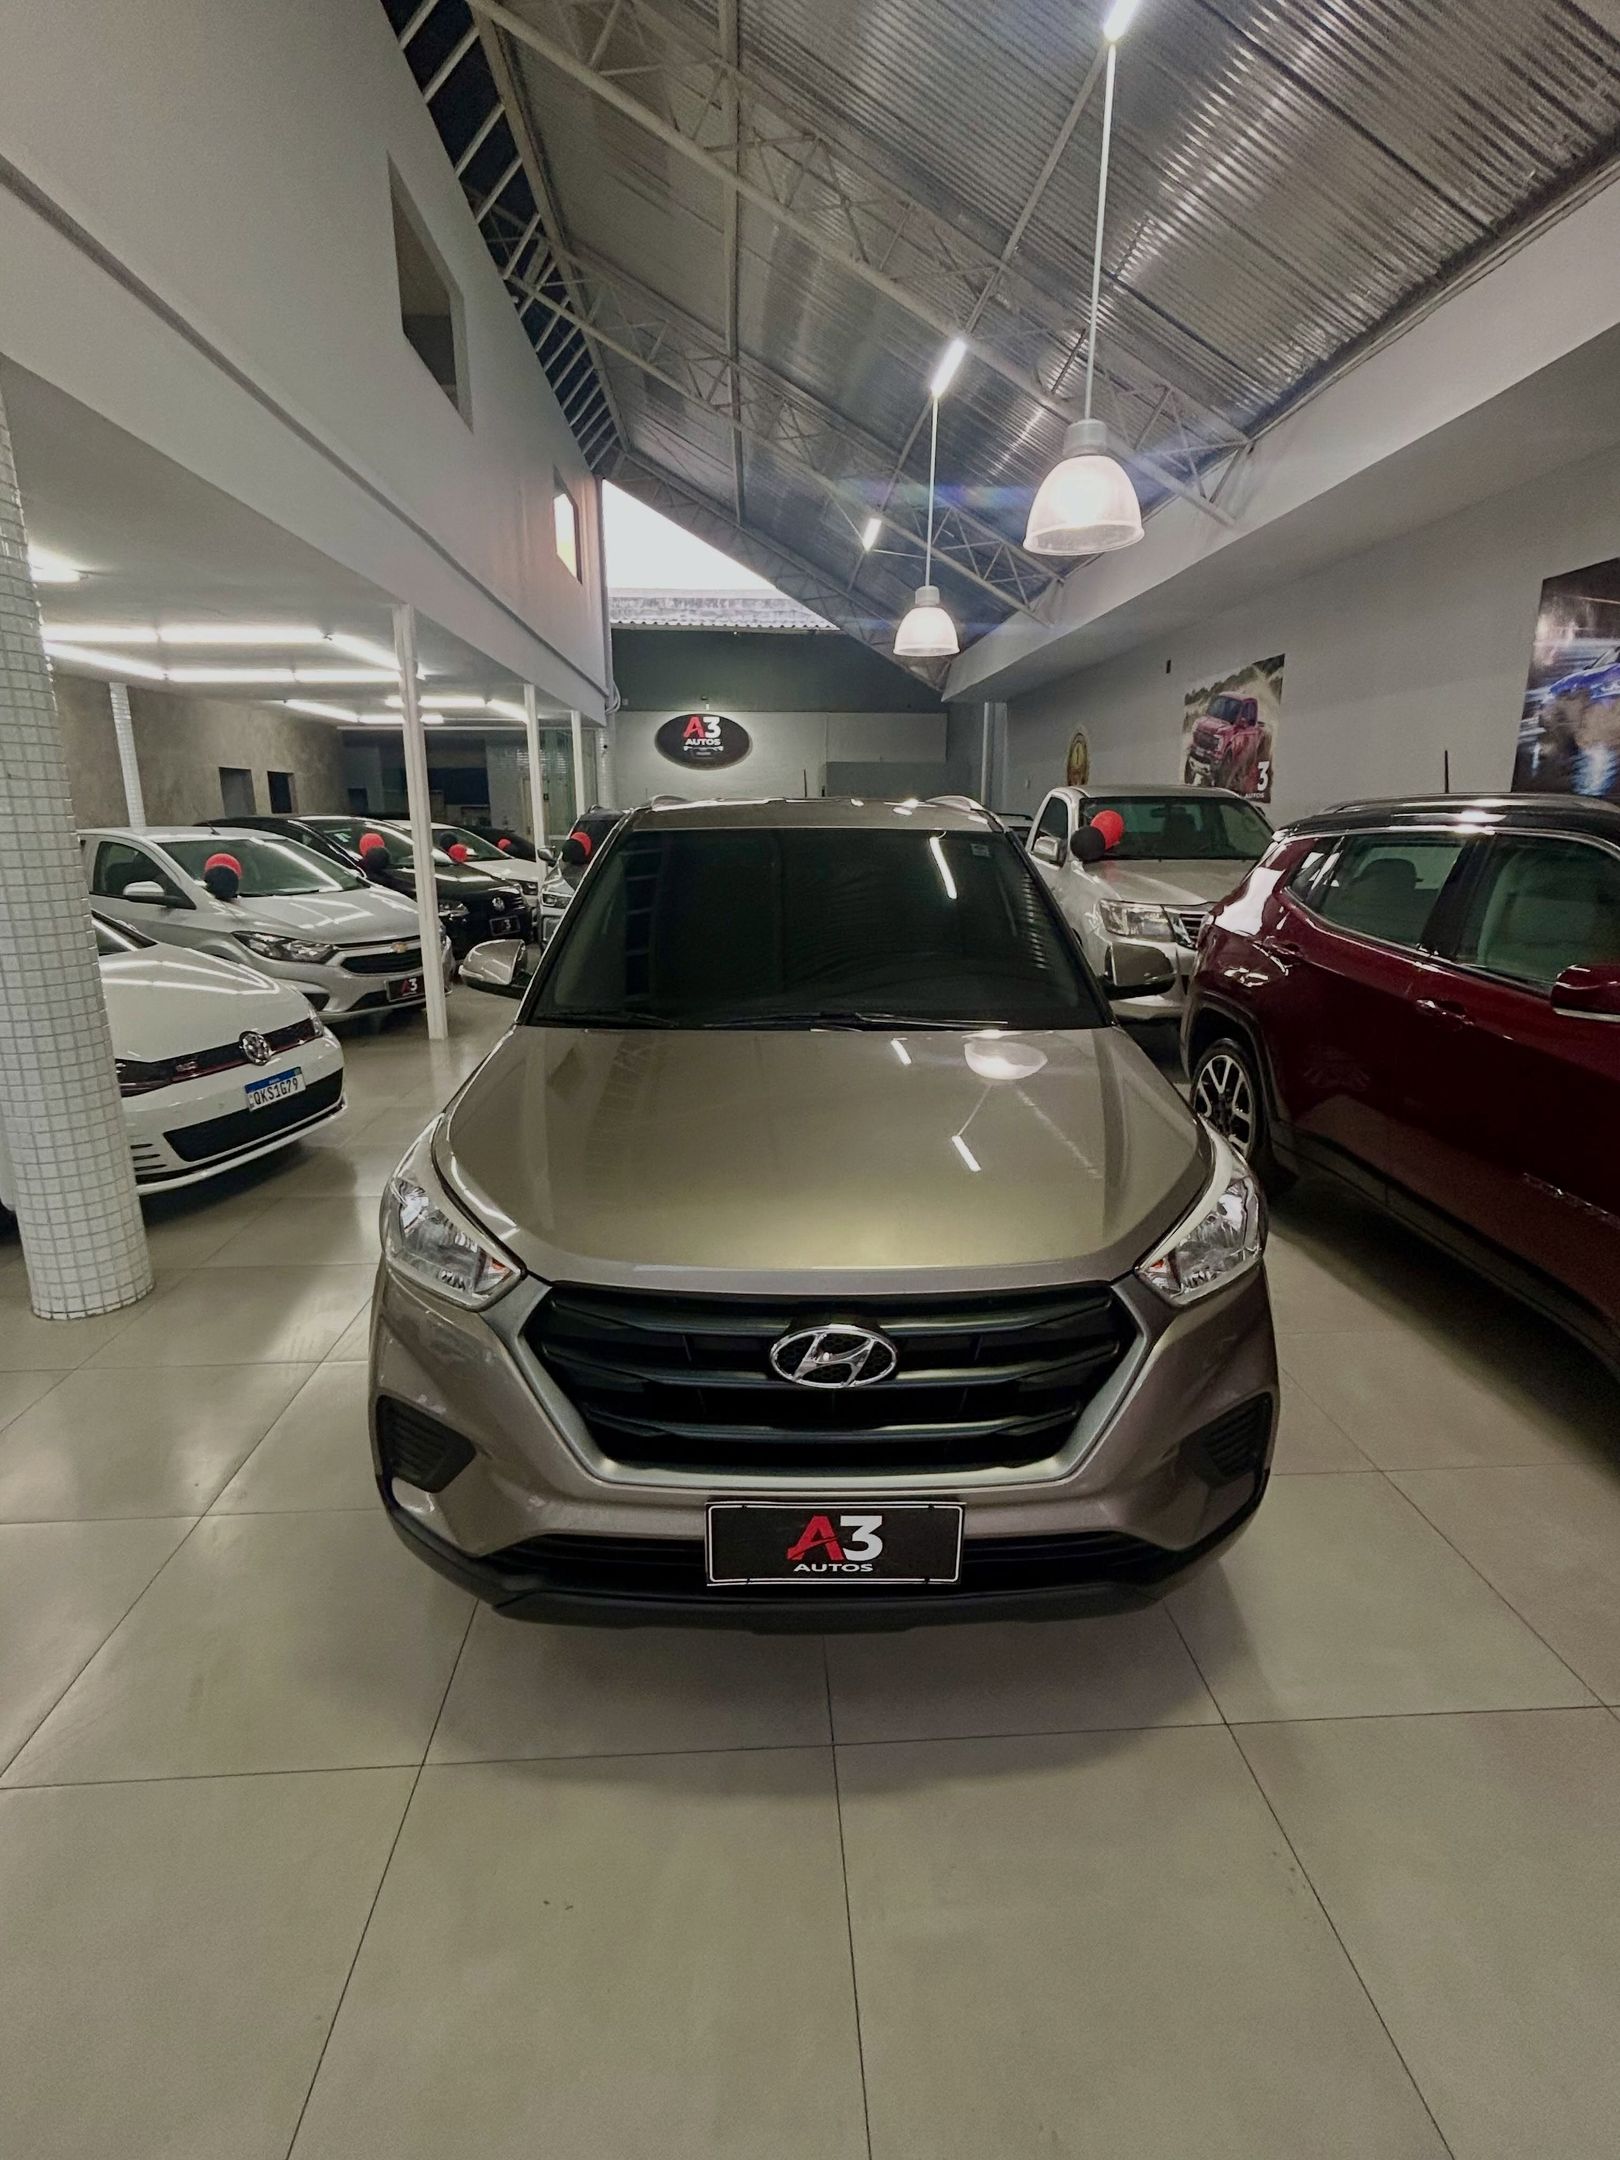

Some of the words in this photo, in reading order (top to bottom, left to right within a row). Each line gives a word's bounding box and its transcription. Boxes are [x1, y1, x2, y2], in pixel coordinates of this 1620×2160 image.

[683, 716, 721, 738] A3
[253, 1077, 298, 1105] QKS1G79
[787, 1514, 883, 1562] A3
[793, 1563, 874, 1572] AUTOS
